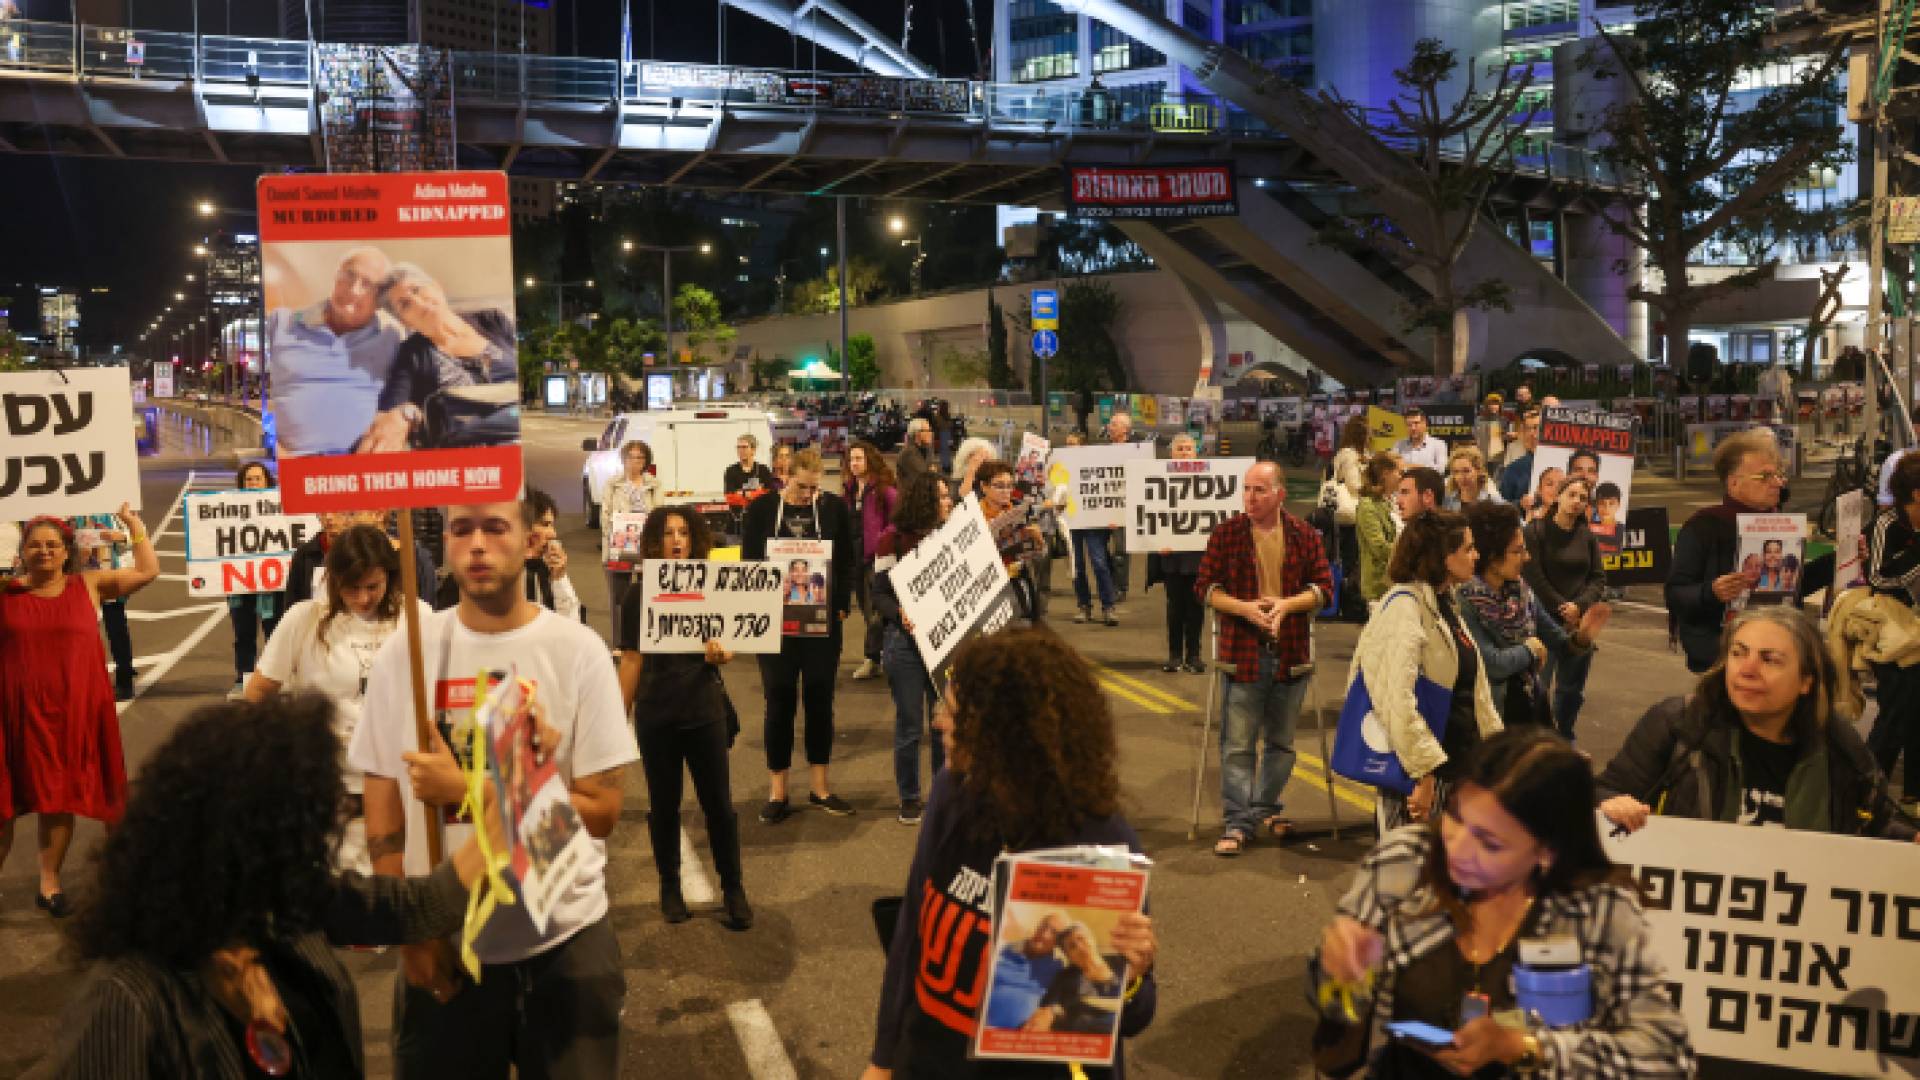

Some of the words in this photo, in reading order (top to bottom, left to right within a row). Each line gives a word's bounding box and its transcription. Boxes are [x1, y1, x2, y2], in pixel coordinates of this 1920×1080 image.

[414, 183, 446, 199] Adina
[450, 183, 487, 198] Moshe
[1165, 172, 1226, 198] משמר
[273, 208, 378, 224] MURDERED
[397, 205, 505, 223] KIDNAPPED
[1543, 423, 1630, 450] KIDNAPPED
[304, 475, 360, 495] BRING
[361, 472, 408, 491] THEM
[412, 468, 460, 489] HOME
[464, 467, 501, 485] NOW
[1145, 475, 1237, 508] עסקה
[198, 502, 251, 520] Bring
[216, 524, 306, 557] HOME
[222, 557, 291, 594] NO
[1640, 865, 1808, 926] לפספ
[1683, 927, 1850, 991] אנחנו
